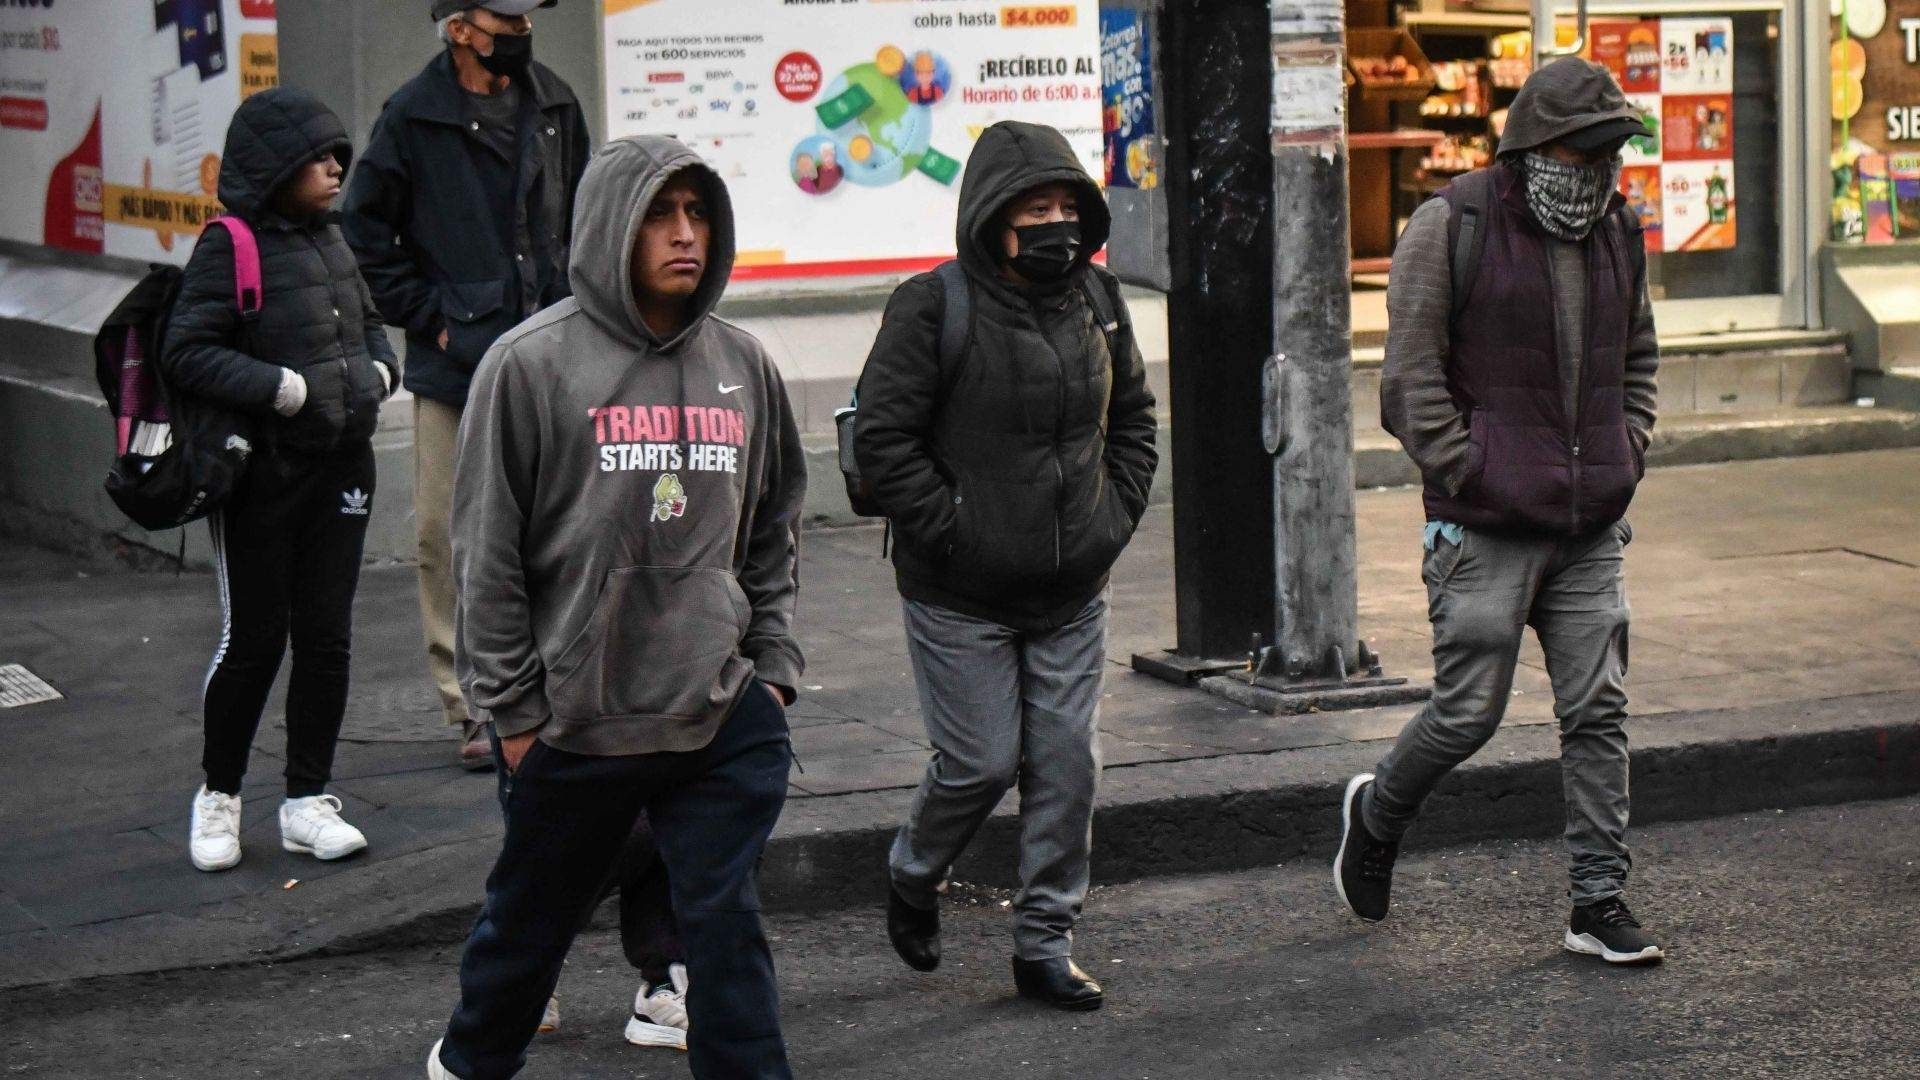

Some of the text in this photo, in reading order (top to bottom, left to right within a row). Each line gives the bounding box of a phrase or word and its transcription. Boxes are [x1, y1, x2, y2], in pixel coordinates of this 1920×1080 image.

[914, 12, 953, 28] cobra
[958, 11, 997, 27] hasta
[617, 38, 643, 47] PAGA
[670, 36, 703, 46] TODOS
[724, 34, 765, 44] RECIBOS
[1900, 18, 1920, 63] T
[661, 48, 689, 60] 600
[690, 48, 747, 59] SERVICIOS
[979, 54, 1096, 84] ¡RECÍBELO AL
[963, 84, 1018, 104] Horario
[1022, 85, 1041, 102] de
[1045, 84, 1078, 102] 6:00
[710, 98, 731, 112] sky
[587, 405, 745, 447] TRADITION
[600, 443, 738, 475] STARTS HERE
[340, 506, 369, 515] adidas
